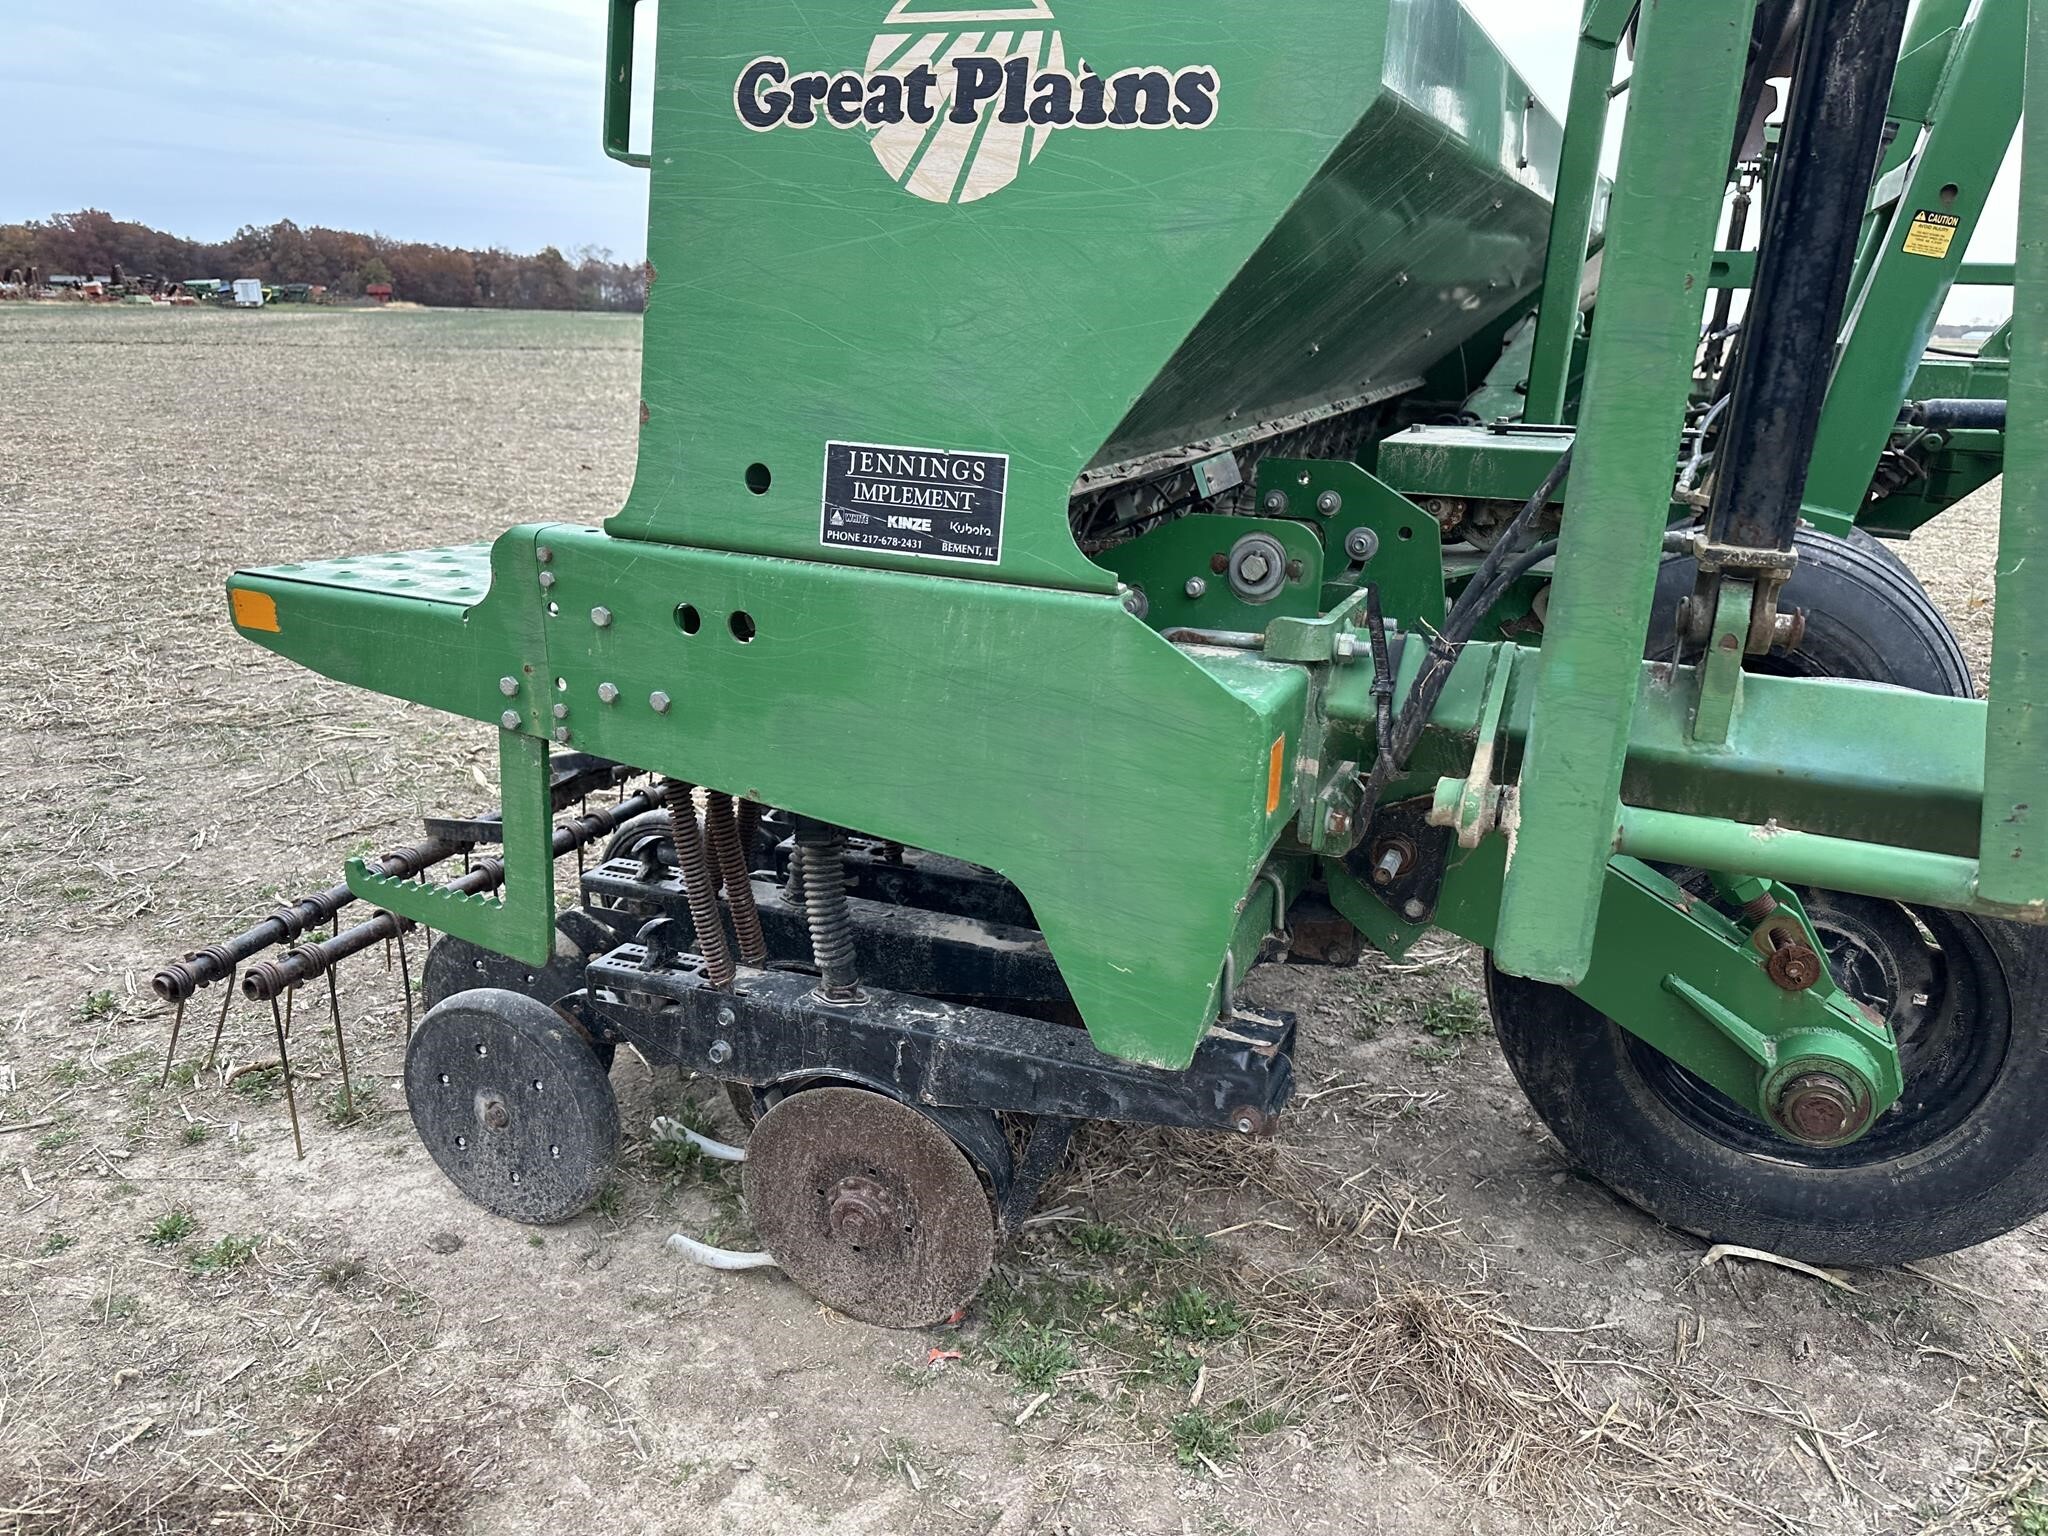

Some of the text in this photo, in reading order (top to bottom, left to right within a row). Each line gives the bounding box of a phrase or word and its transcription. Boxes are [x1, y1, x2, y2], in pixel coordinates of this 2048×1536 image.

[736, 56, 1217, 128] Great Plains
[1927, 213, 1960, 226] CAUTION
[846, 450, 986, 482] JENNINGS
[853, 481, 976, 511] IMPLEMENT
[844, 512, 869, 525] WHITE
[887, 515, 932, 532] KINZE
[949, 520, 992, 537] Kubota
[826, 529, 922, 549] PHONE 217-678-2431
[941, 541, 994, 557] BEMENT, IL
